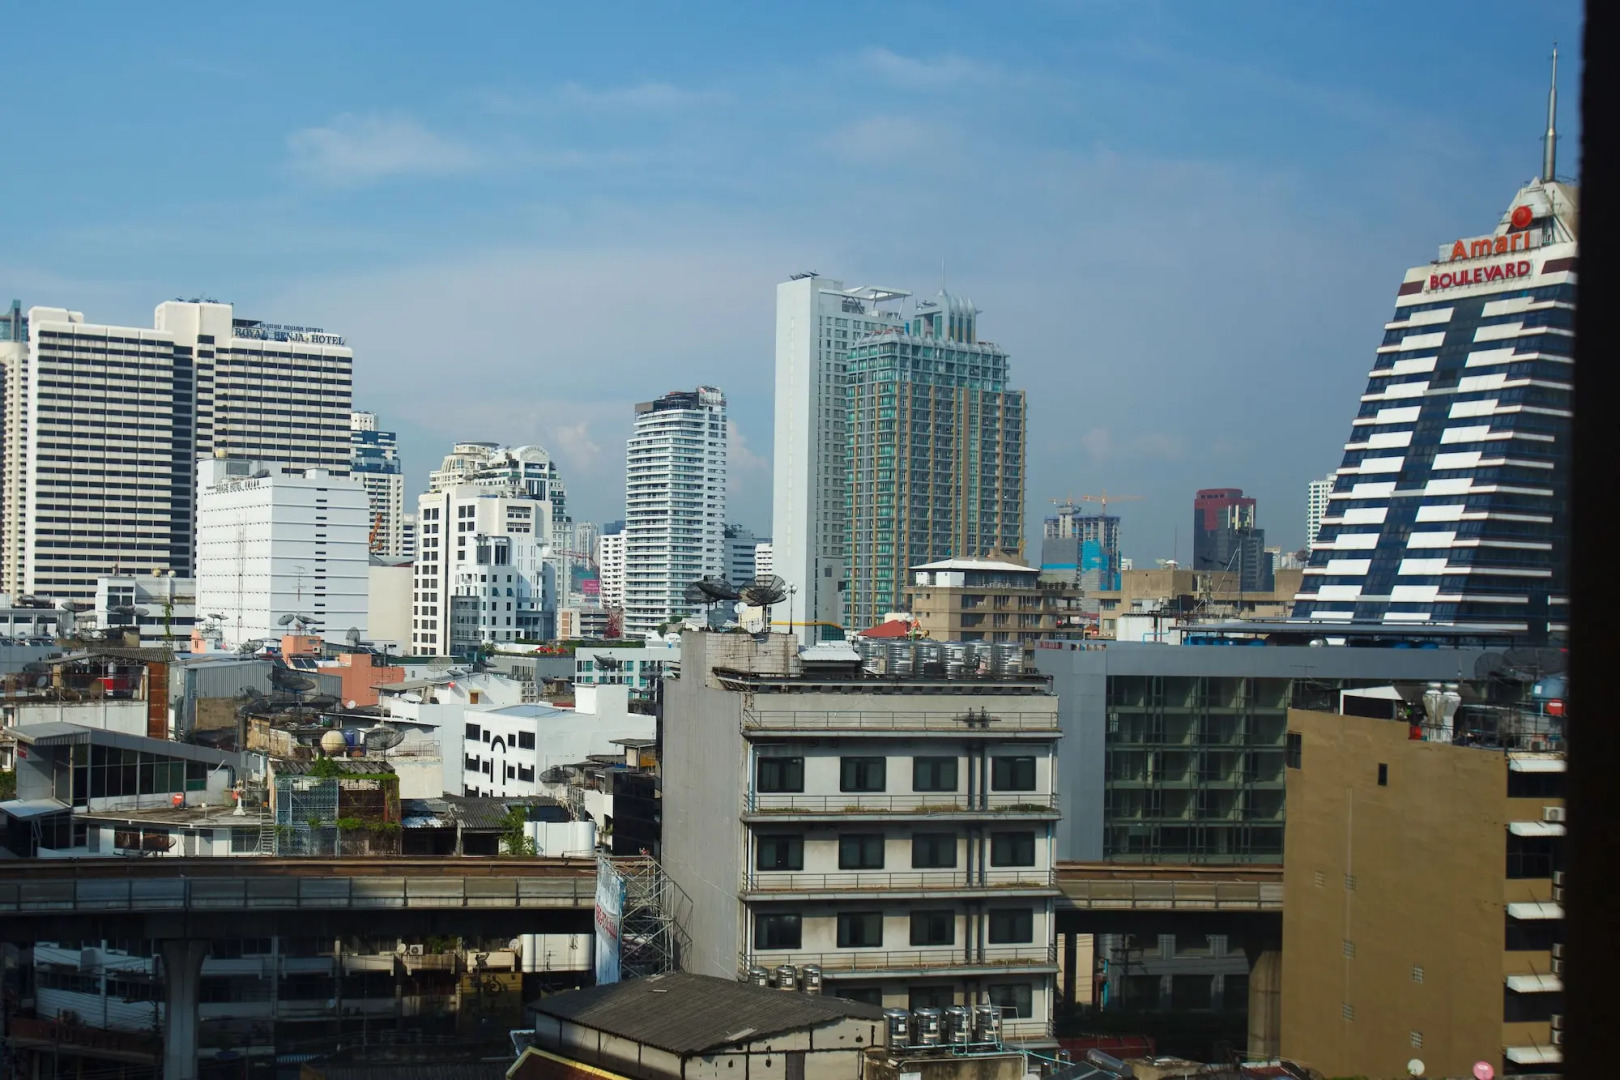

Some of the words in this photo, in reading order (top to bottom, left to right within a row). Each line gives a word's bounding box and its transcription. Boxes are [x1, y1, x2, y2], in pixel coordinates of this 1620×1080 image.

[1451, 231, 1530, 260] Amari
[1430, 261, 1531, 290] BOULEVARD
[234, 327, 268, 340] ROYAL
[311, 335, 345, 345] HOTEL
